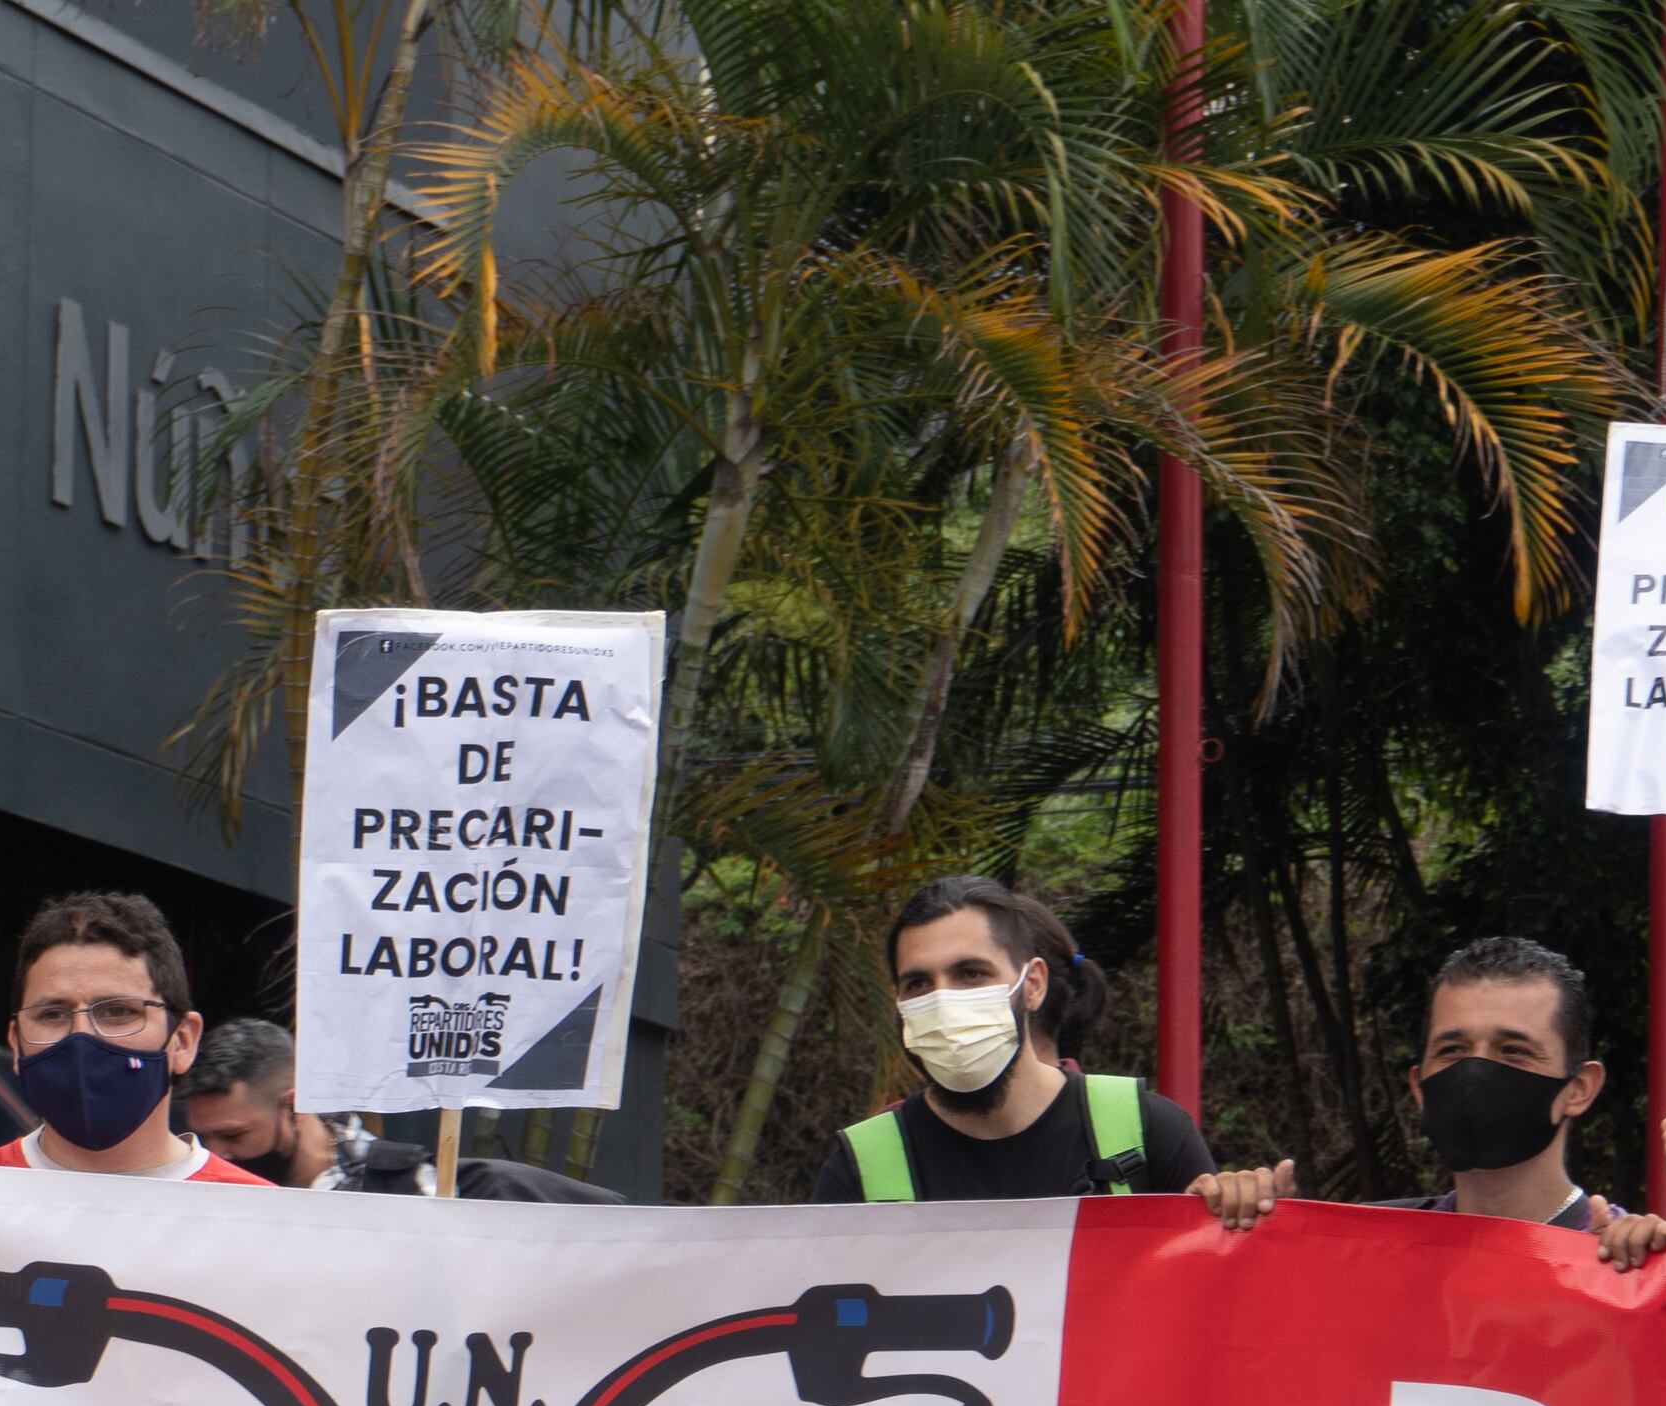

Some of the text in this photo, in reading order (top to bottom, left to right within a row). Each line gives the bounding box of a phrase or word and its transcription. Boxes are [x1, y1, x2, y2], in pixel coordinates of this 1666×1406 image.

[394, 676, 590, 728] ¡BASTA
[458, 741, 515, 785] DE
[353, 807, 604, 851] PRECARI-
[372, 857, 570, 915] ZACIÓN
[340, 933, 584, 981] LABORAL!
